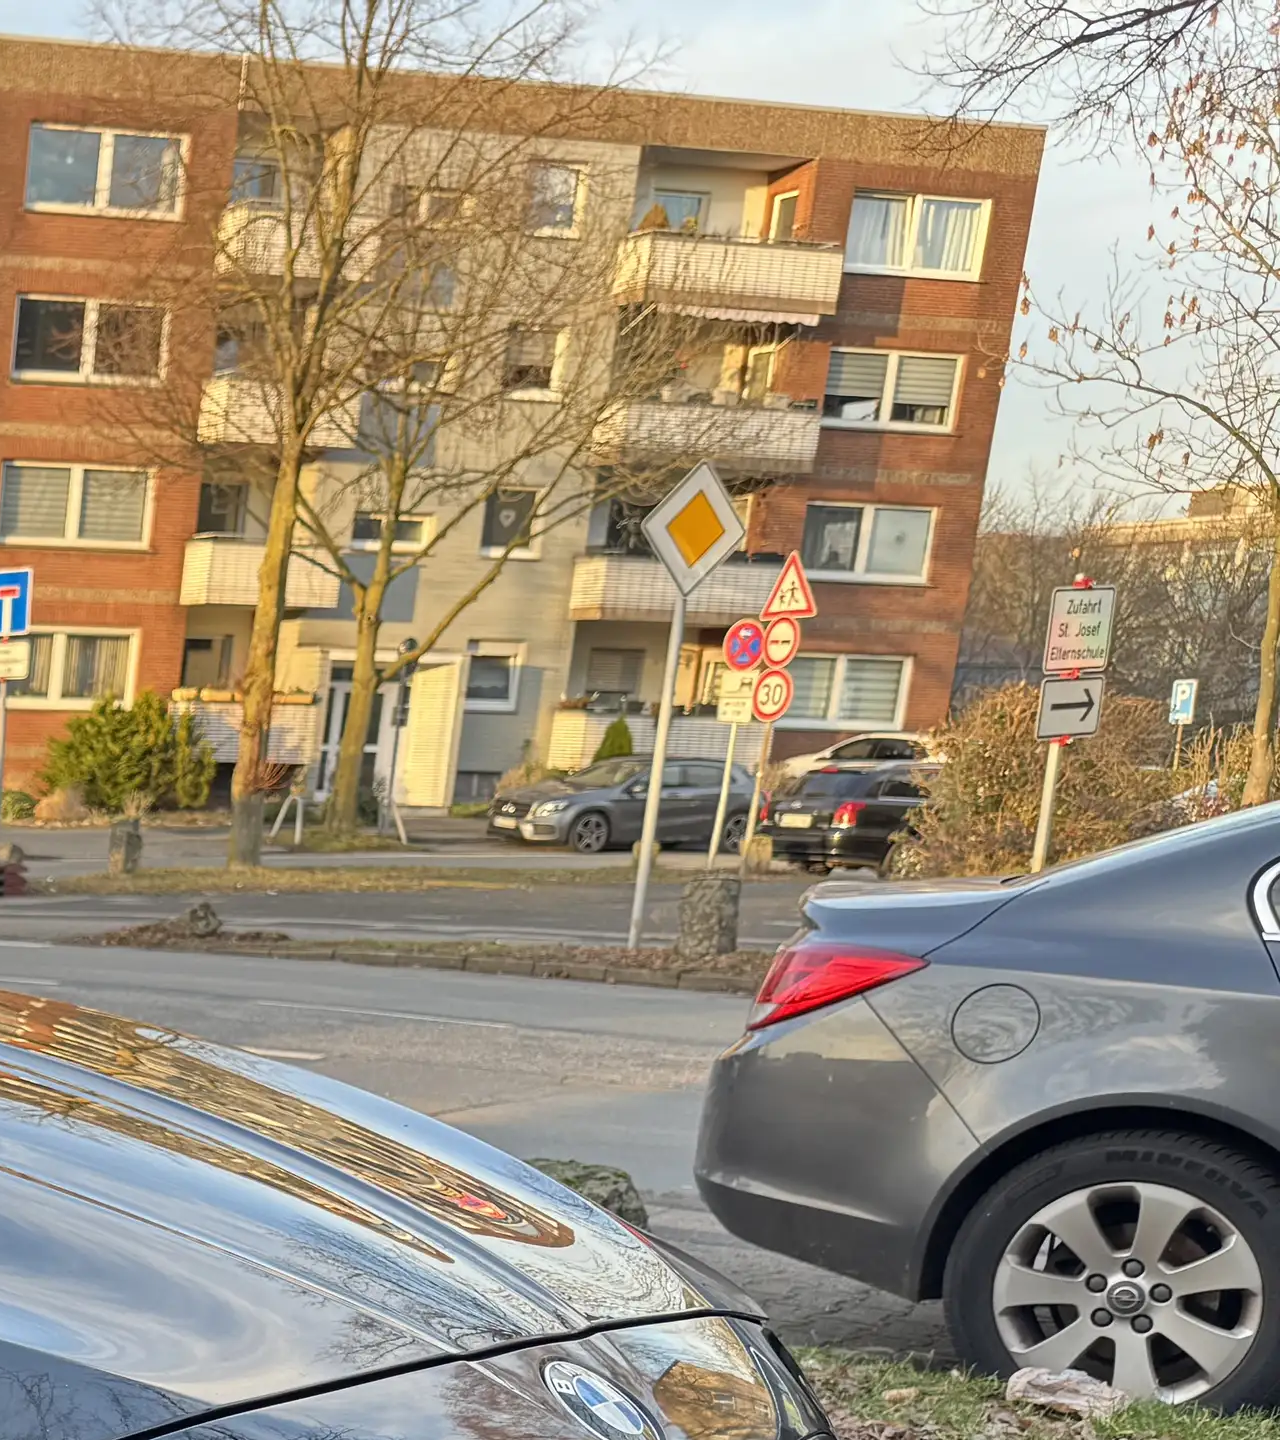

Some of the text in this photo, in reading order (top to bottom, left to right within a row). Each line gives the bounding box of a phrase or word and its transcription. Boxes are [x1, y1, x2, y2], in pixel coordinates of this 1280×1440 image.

[1066, 598, 1102, 615] Zufahrt
[1075, 622, 1101, 638] Josef
[1050, 645, 1105, 662] Elternschule
[760, 684, 783, 706] 30
